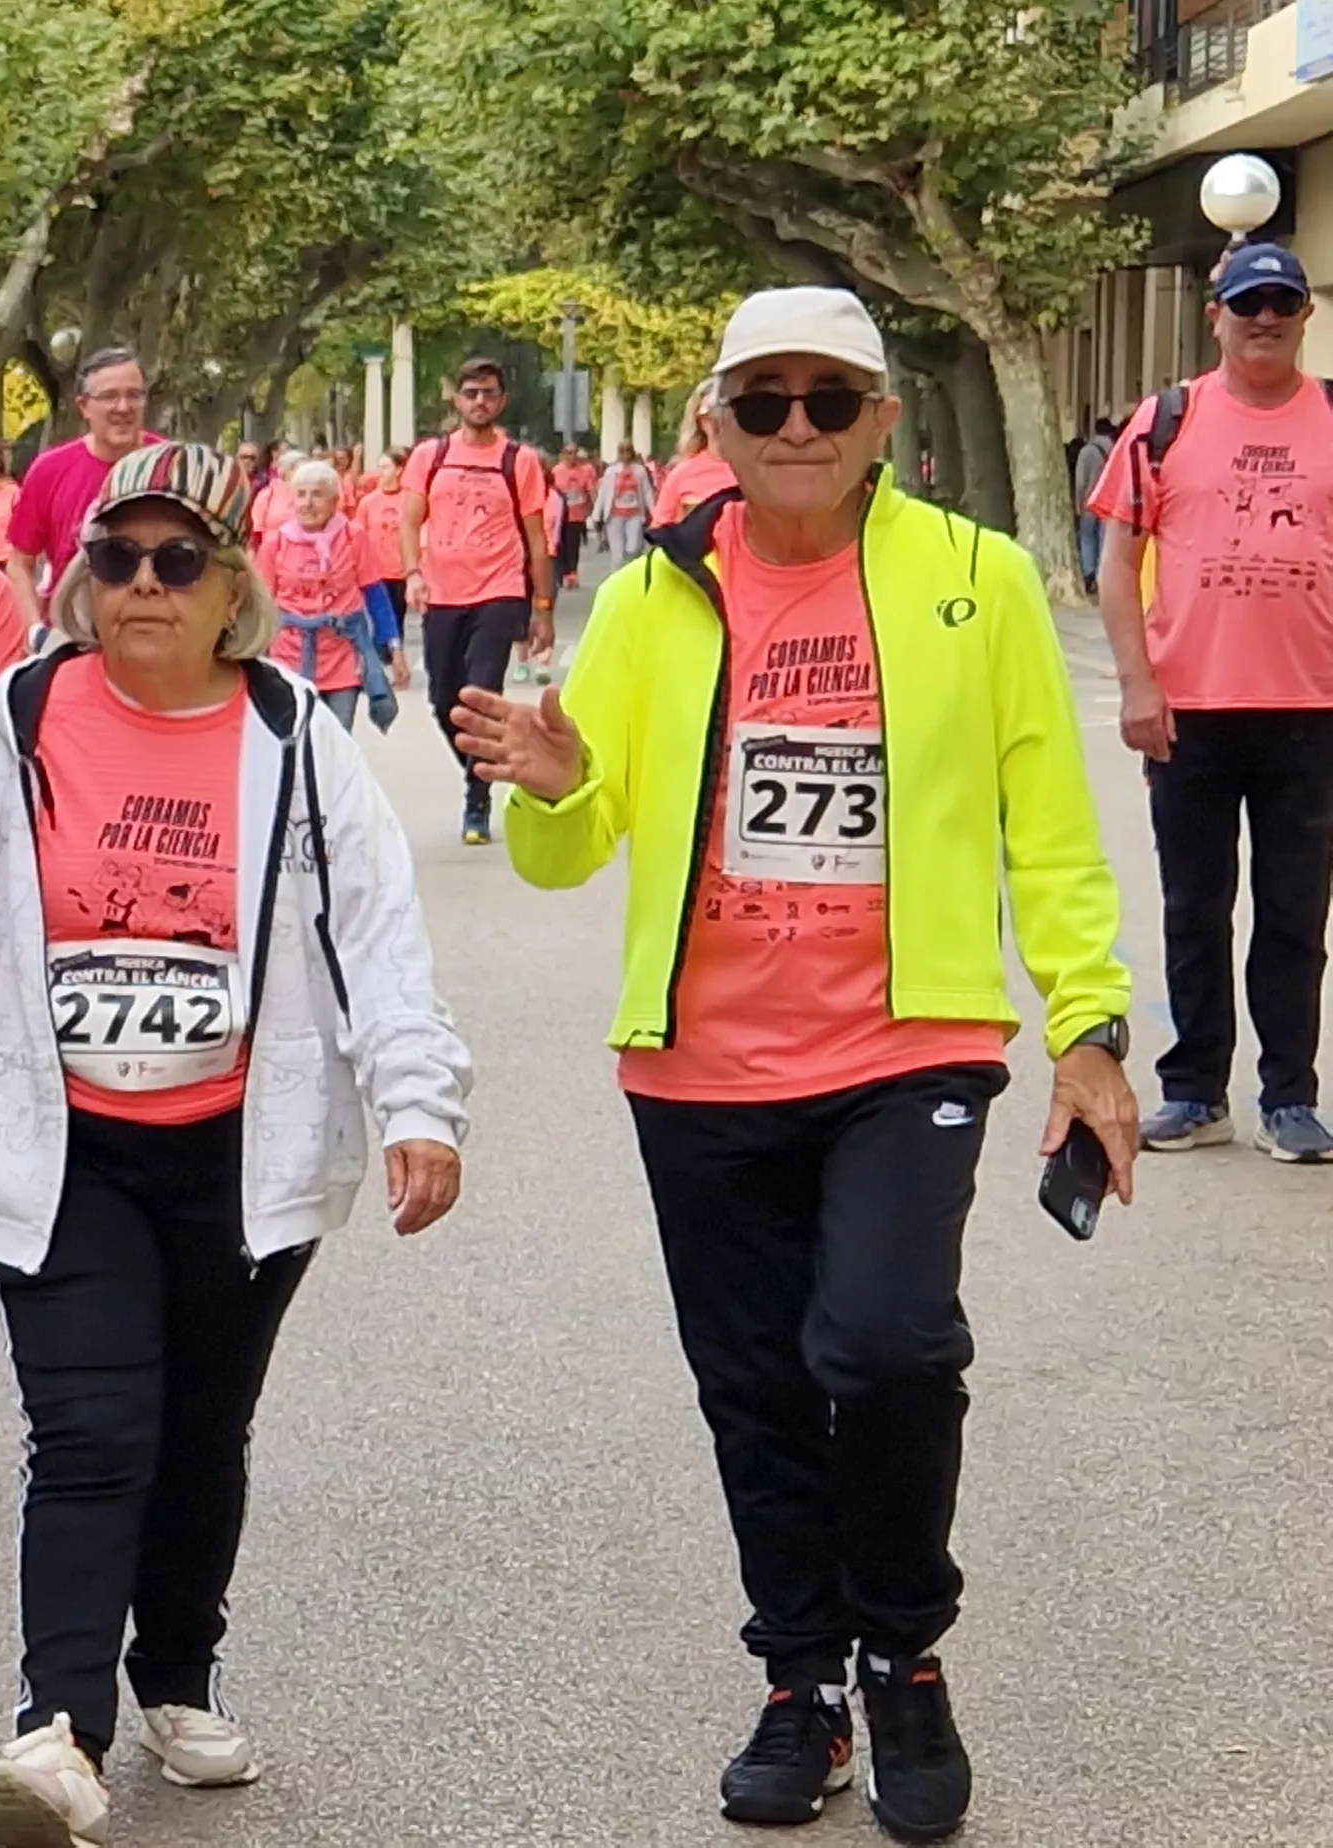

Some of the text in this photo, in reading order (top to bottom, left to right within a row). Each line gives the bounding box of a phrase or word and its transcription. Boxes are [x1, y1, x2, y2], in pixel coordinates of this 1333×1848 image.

[766, 634, 857, 670] CORRAMOS
[747, 662, 870, 702] POR LA CIENCIA
[753, 754, 828, 773] CONTRA
[832, 758, 851, 774] EL
[121, 794, 212, 830] CORRAMOS
[746, 779, 878, 839] 273
[96, 822, 220, 860] POR LA CIENCIA
[61, 968, 128, 985] CONTRA
[131, 970, 151, 985] EL
[55, 993, 224, 1046] 2742
